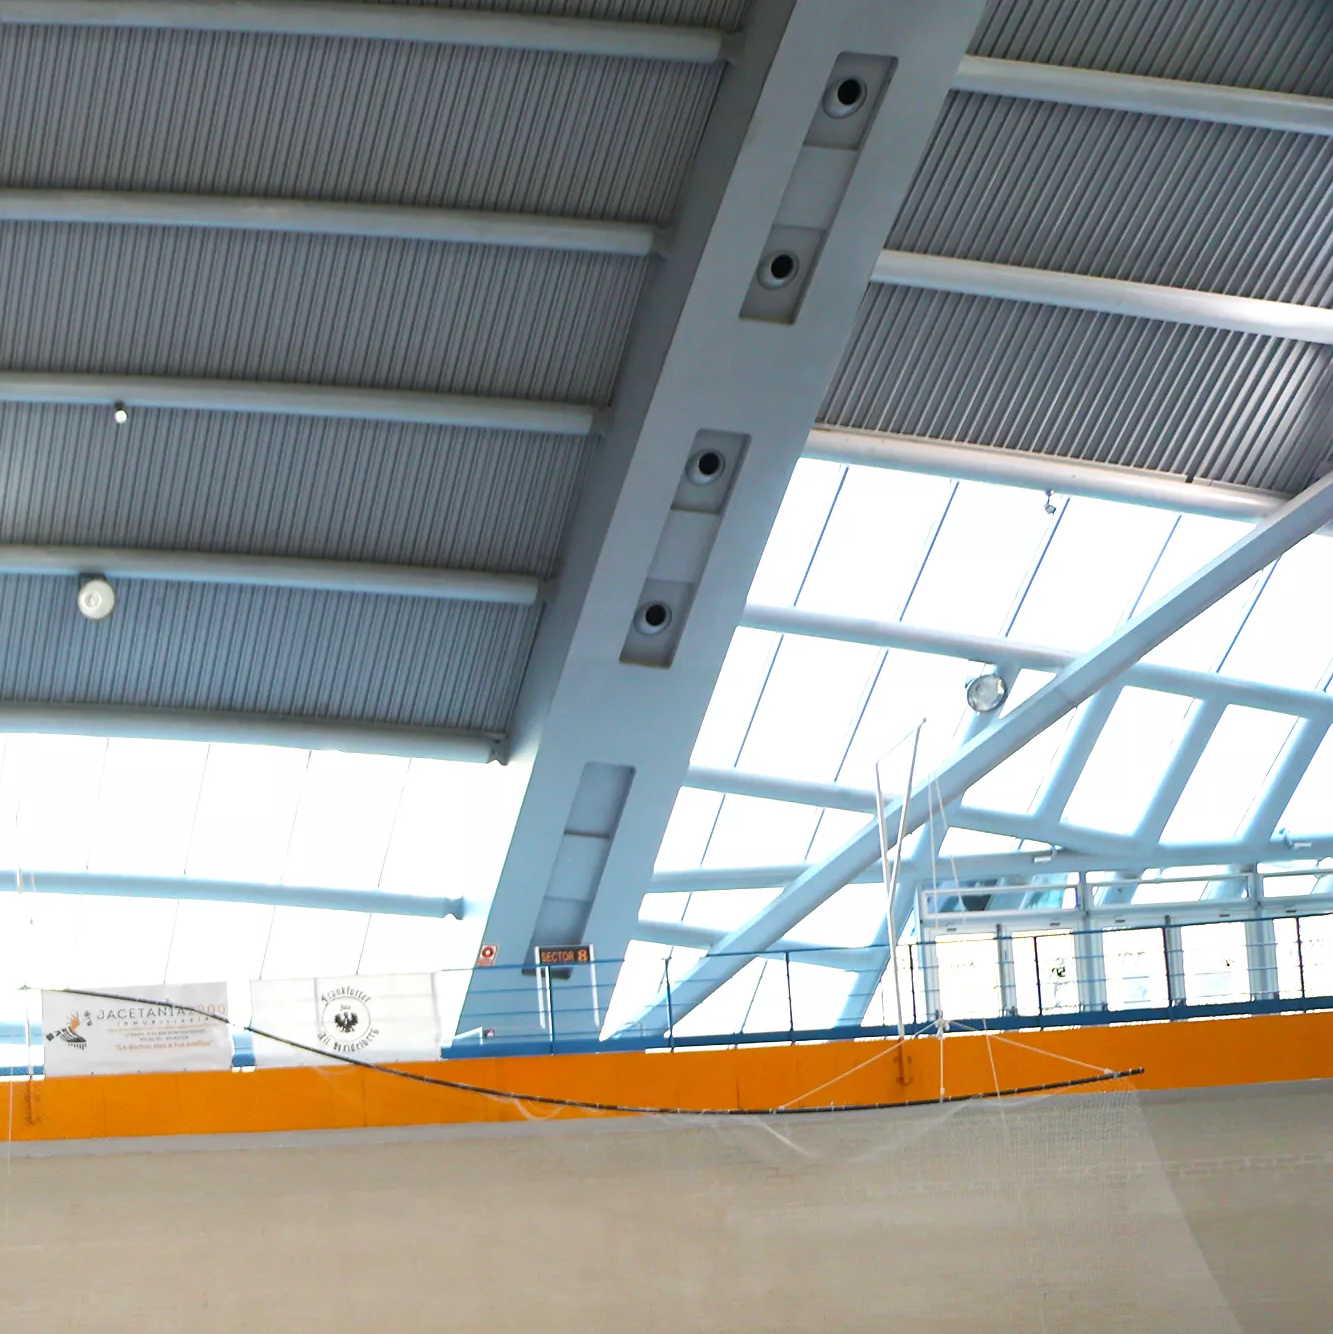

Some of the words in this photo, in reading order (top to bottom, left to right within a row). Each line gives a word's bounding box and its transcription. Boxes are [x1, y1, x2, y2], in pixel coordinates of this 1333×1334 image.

[541, 951, 574, 962] SECTOR
[577, 949, 588, 962] 8
[96, 1006, 186, 1020] JACETANIA
